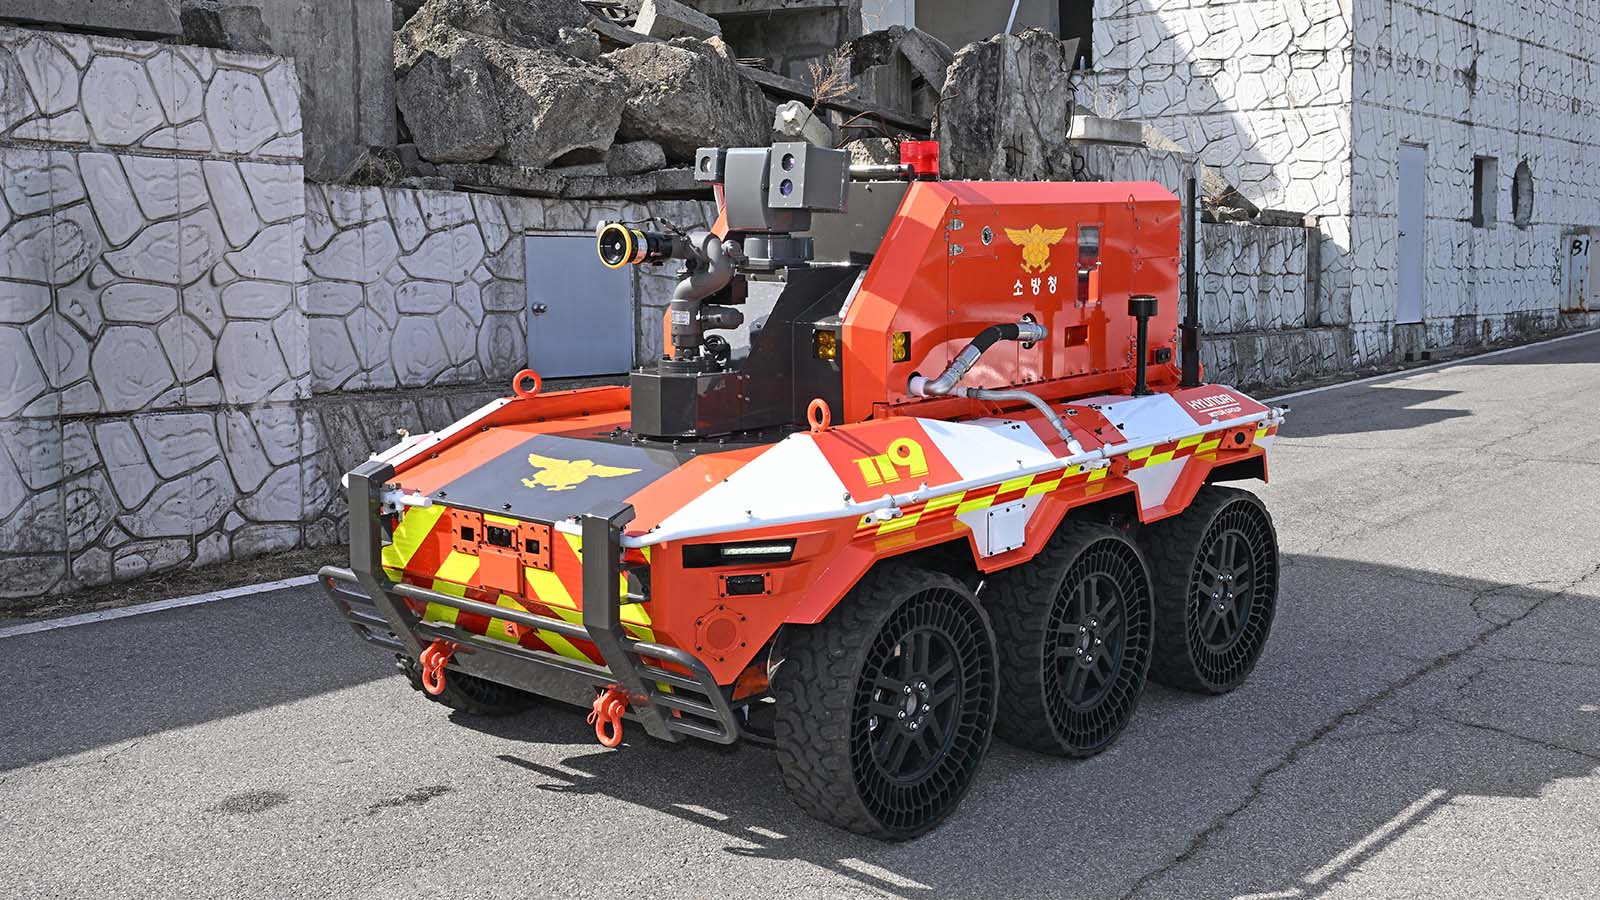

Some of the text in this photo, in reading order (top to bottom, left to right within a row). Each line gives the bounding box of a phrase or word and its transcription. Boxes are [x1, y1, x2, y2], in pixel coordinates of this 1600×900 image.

[1013, 276, 1057, 296] 소방청
[1186, 393, 1237, 410] HYUNDAI
[853, 437, 929, 487] 119
